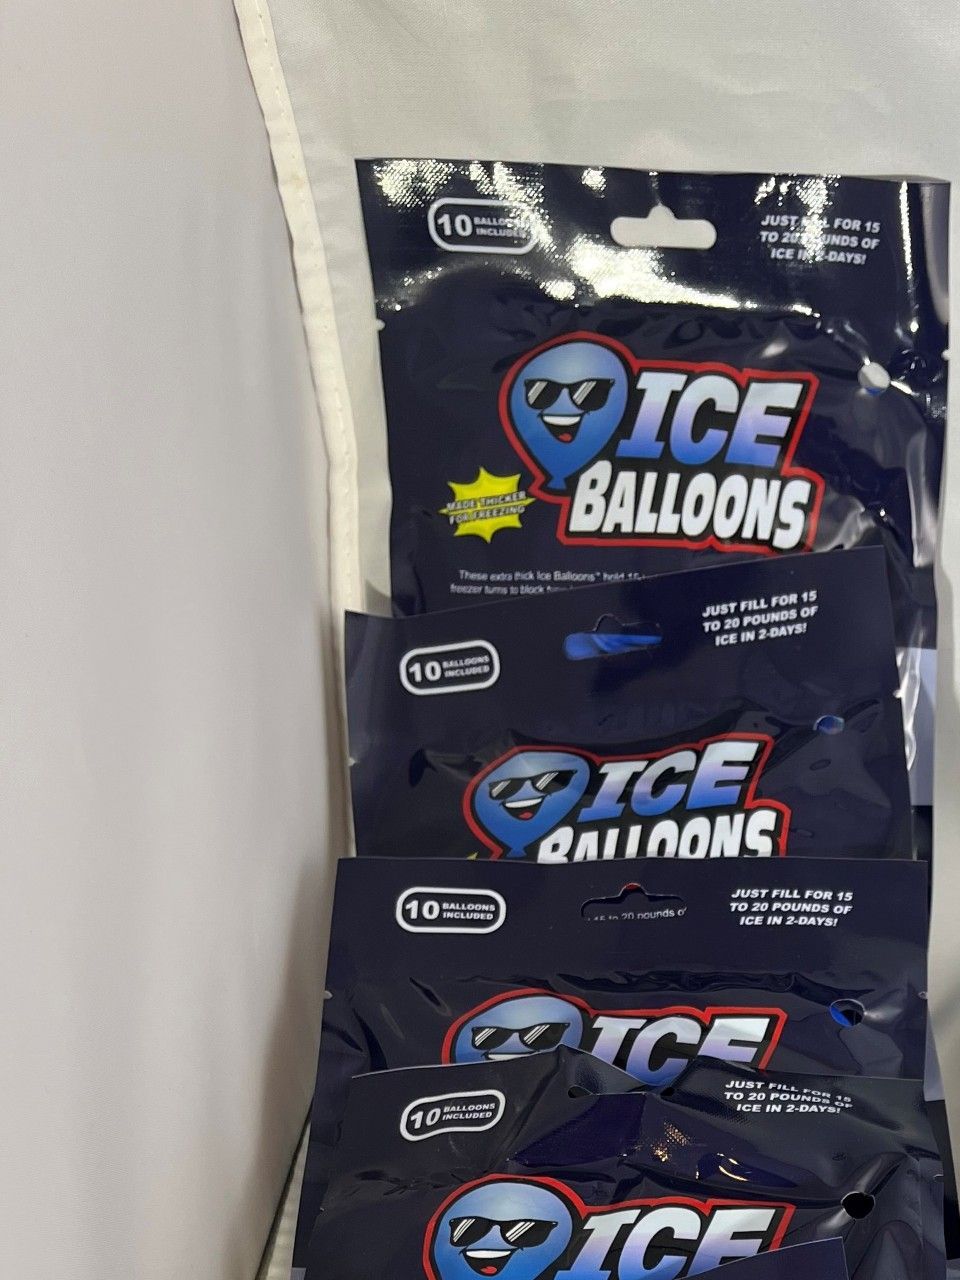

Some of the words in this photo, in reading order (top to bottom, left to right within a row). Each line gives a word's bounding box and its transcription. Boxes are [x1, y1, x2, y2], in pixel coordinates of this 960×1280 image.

[437, 213, 473, 239] 10
[616, 371, 803, 467] ICE
[569, 460, 812, 550] BALLOONS
[702, 602, 738, 618] JUST
[739, 598, 768, 612] FILL
[770, 593, 798, 607] FOR
[801, 590, 817, 602] 15
[702, 620, 721, 633] TO
[723, 617, 741, 630] 20
[742, 608, 798, 627] POUNDS
[799, 605, 819, 618] OF
[715, 633, 738, 646] ICE
[740, 630, 756, 642] IN
[758, 622, 808, 640] 2-DAYS!
[408, 660, 442, 683] 10
[443, 655, 490, 669] BALLOONS
[444, 664, 491, 678] INCLUDED
[577, 741, 759, 823] ICE
[731, 888, 769, 899] JUST
[771, 889, 801, 899] FILL
[804, 890, 833, 901] FOR
[837, 891, 853, 902] 15
[405, 900, 440, 920] 10
[442, 902, 496, 912] BALLOONS
[442, 911, 494, 920] INCLUDED
[729, 902, 749, 912] TO
[751, 902, 769, 912] 20
[771, 902, 830, 914] POUNDS
[833, 905, 853, 915] OF
[739, 916, 764, 926] ICE
[766, 915, 783, 925] IN
[785, 915, 839, 927] 2-DAYS!
[443, 1101, 497, 1114] BALLOONS
[443, 1111, 495, 1123] INCLUDED
[409, 1110, 440, 1131] 10
